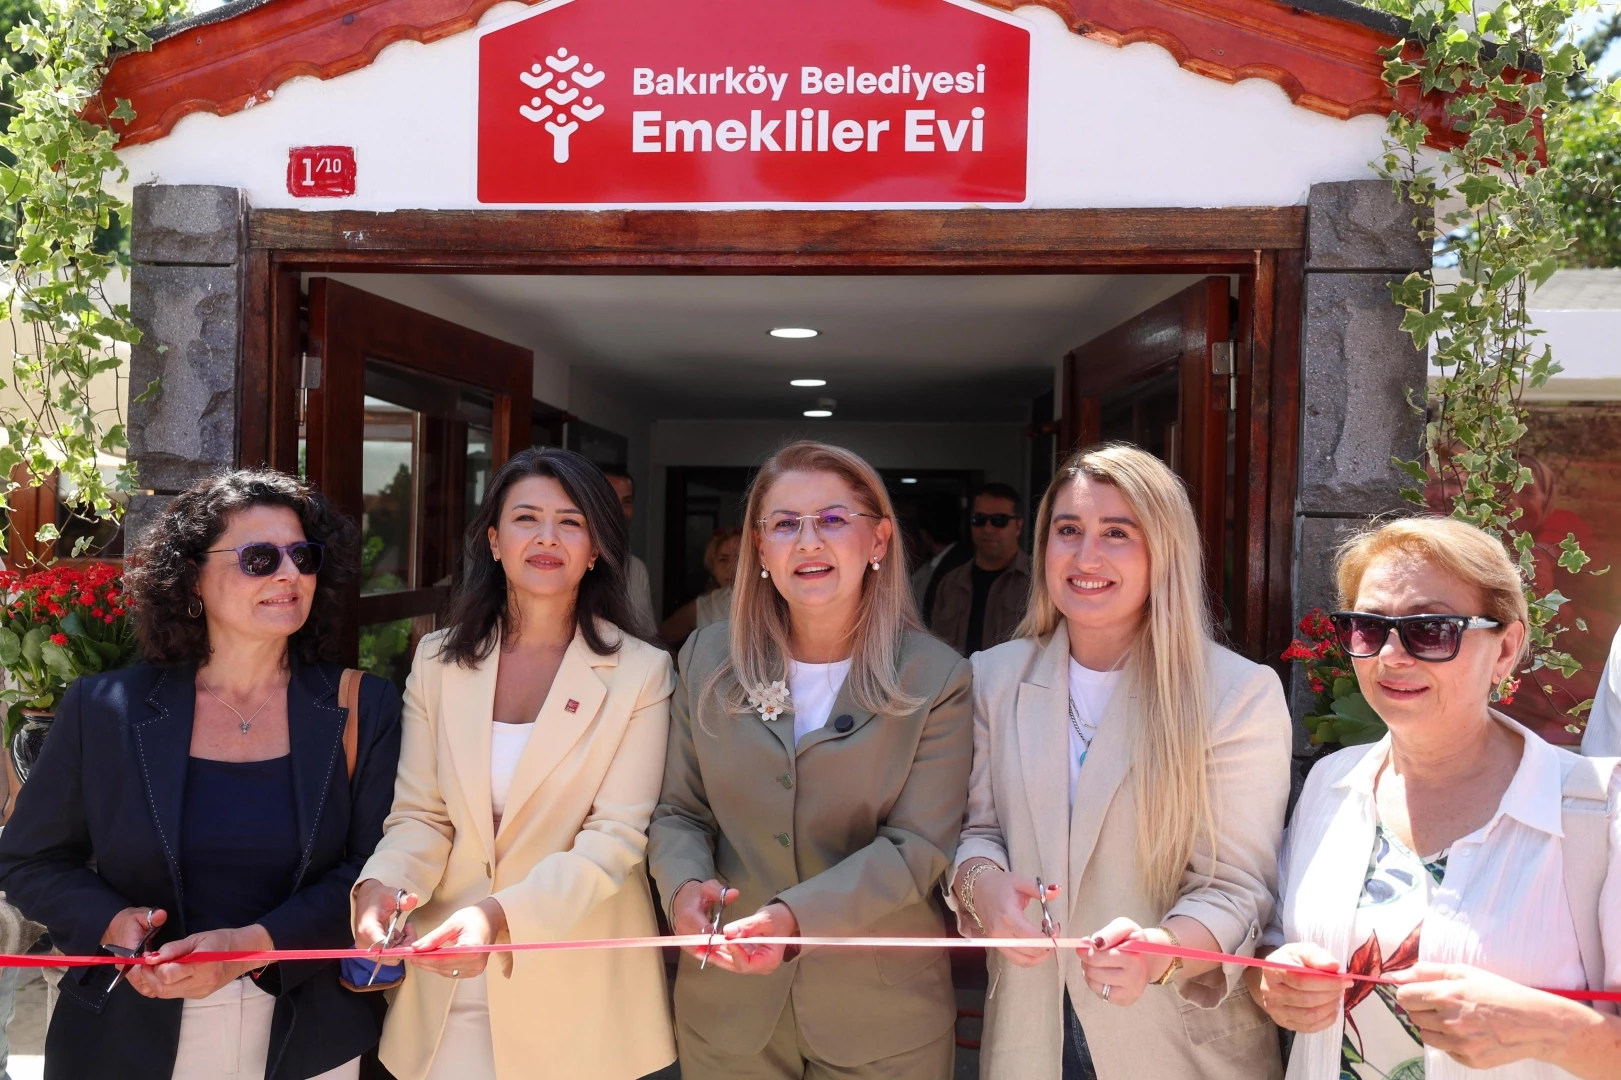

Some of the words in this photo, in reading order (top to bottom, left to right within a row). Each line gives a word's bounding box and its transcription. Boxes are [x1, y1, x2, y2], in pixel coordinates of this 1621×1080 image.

[633, 65, 789, 101] Bakırköy
[801, 64, 986, 101] Belediyesi
[632, 107, 890, 153] Emekliler
[904, 106, 985, 152] Evi
